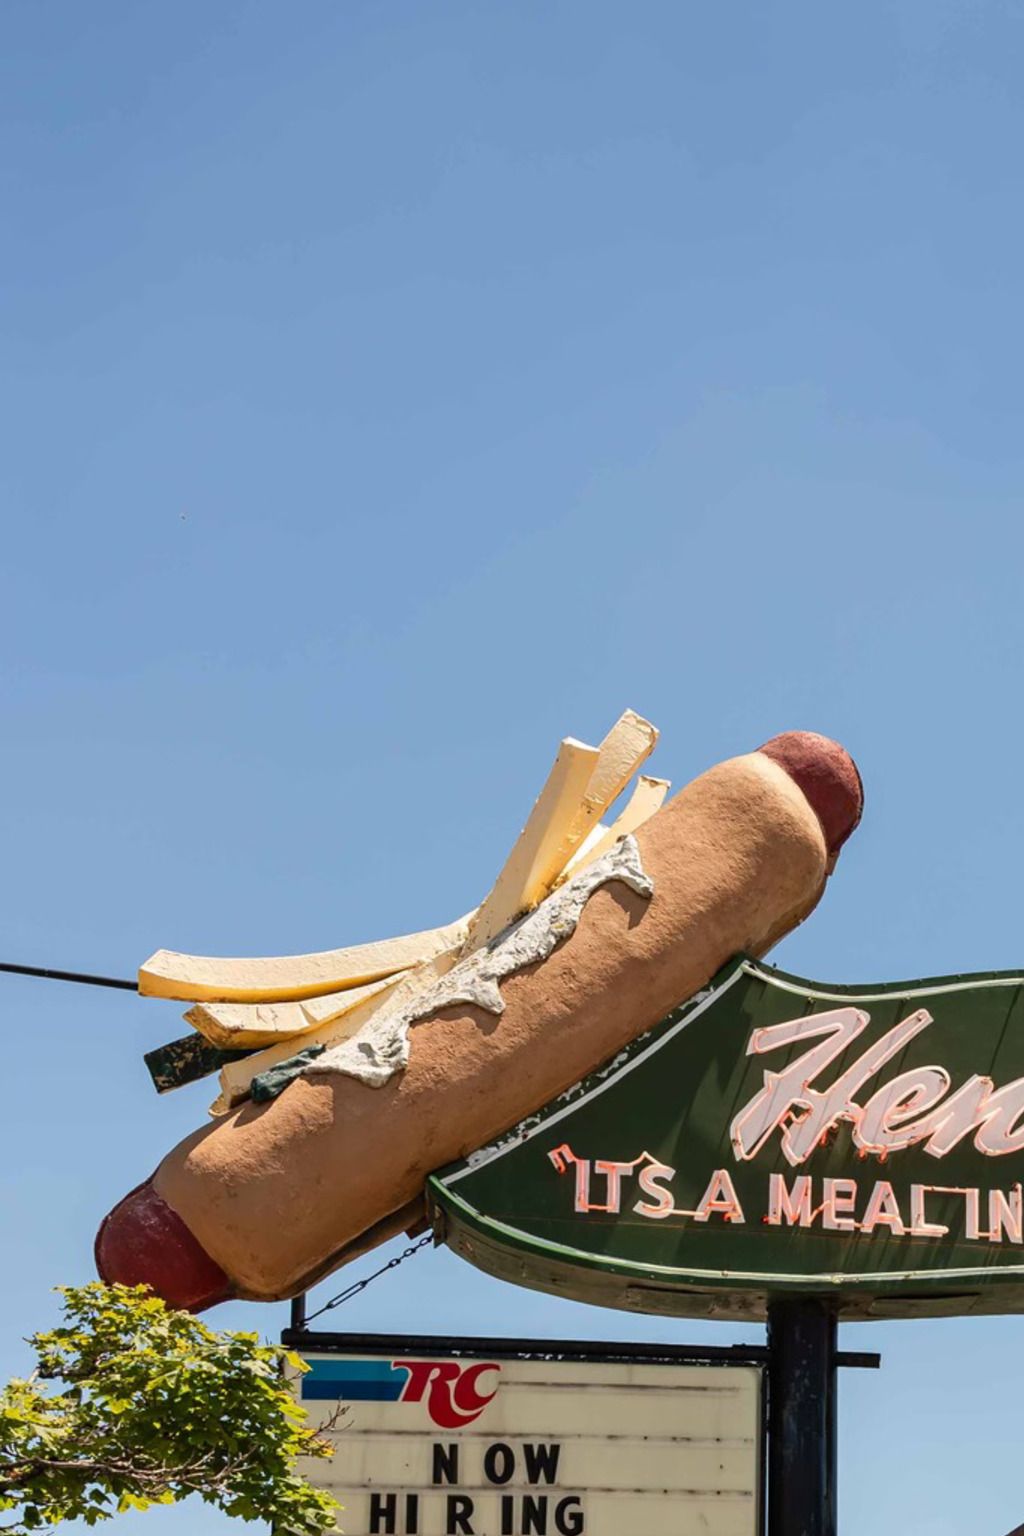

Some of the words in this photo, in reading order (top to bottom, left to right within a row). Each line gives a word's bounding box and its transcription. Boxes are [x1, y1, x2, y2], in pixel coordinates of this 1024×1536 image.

[694, 1169, 745, 1223] A
[768, 1173, 949, 1237] MEAL
[965, 1184, 1024, 1244] IN
[392, 1360, 501, 1430] RC
[432, 1443, 561, 1485] NOW
[369, 1493, 585, 1536] HIRING
